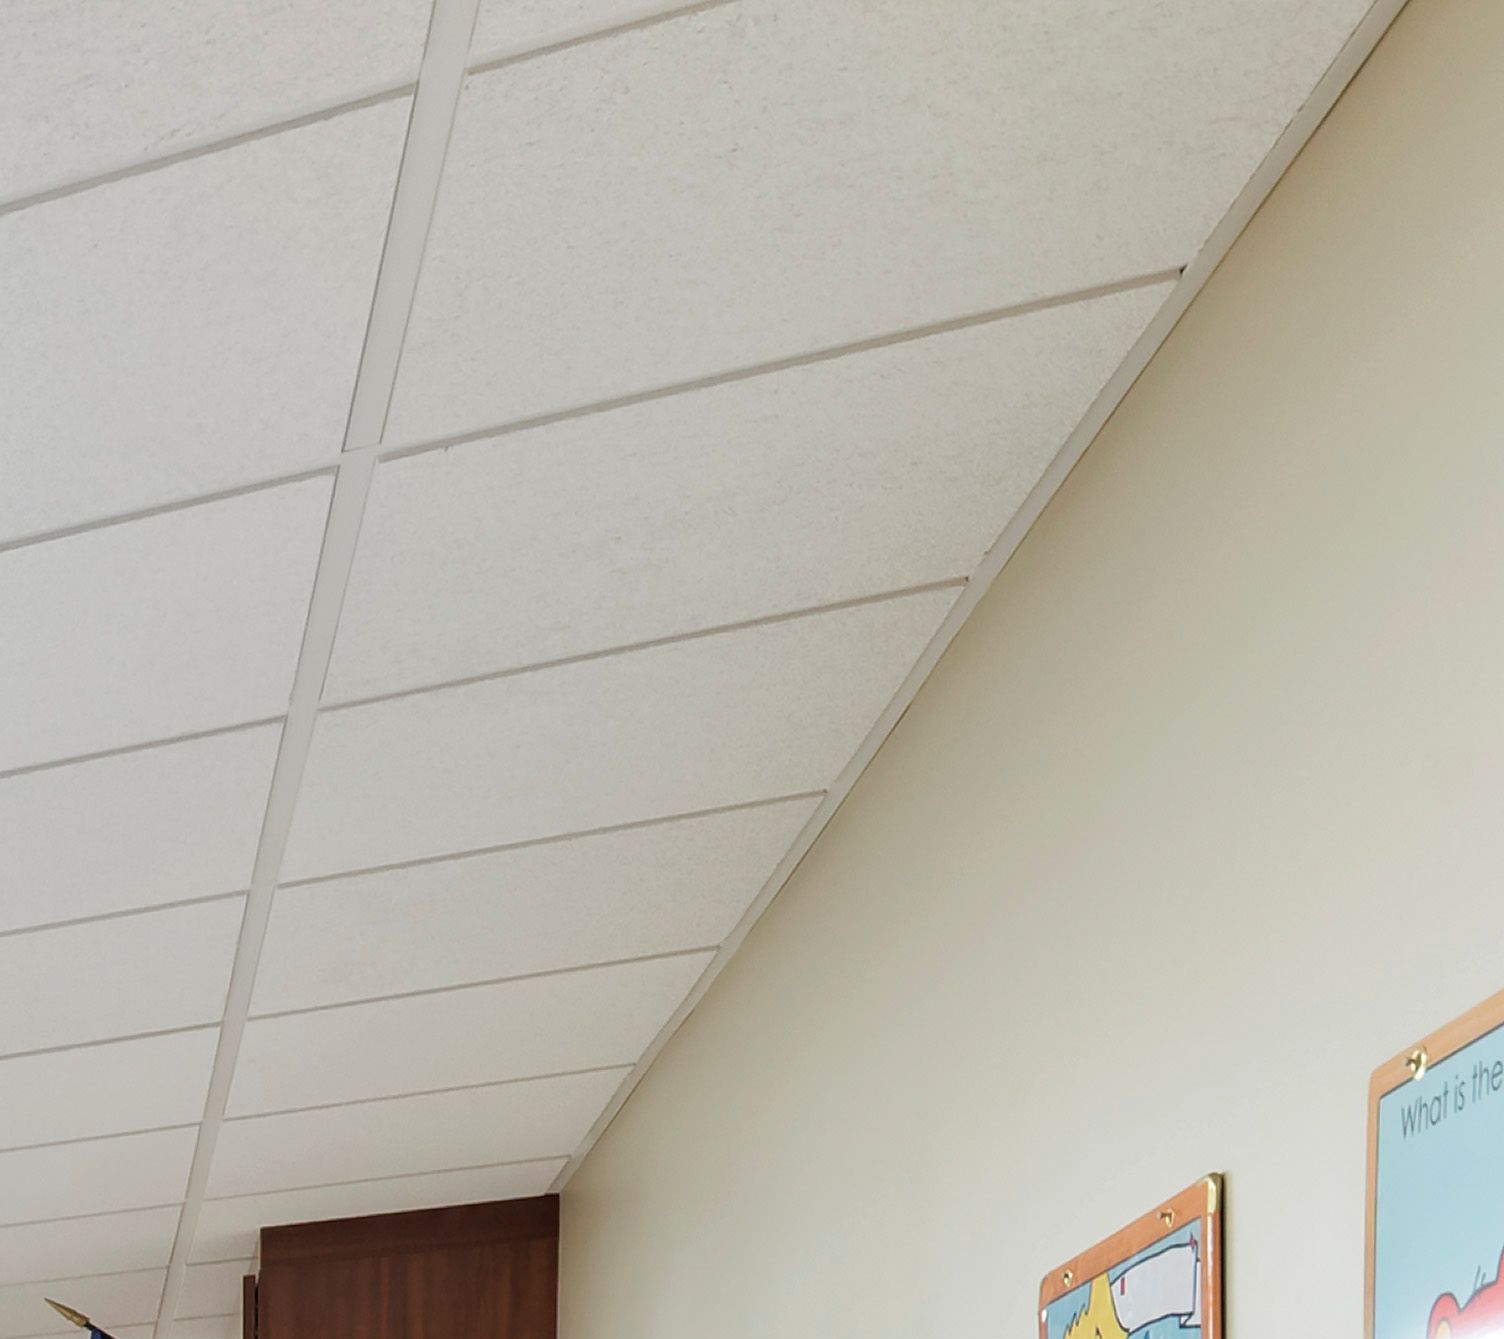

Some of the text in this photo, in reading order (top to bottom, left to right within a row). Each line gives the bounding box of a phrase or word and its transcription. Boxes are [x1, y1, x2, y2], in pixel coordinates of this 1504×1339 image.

[1401, 1060, 1504, 1139] What is the
